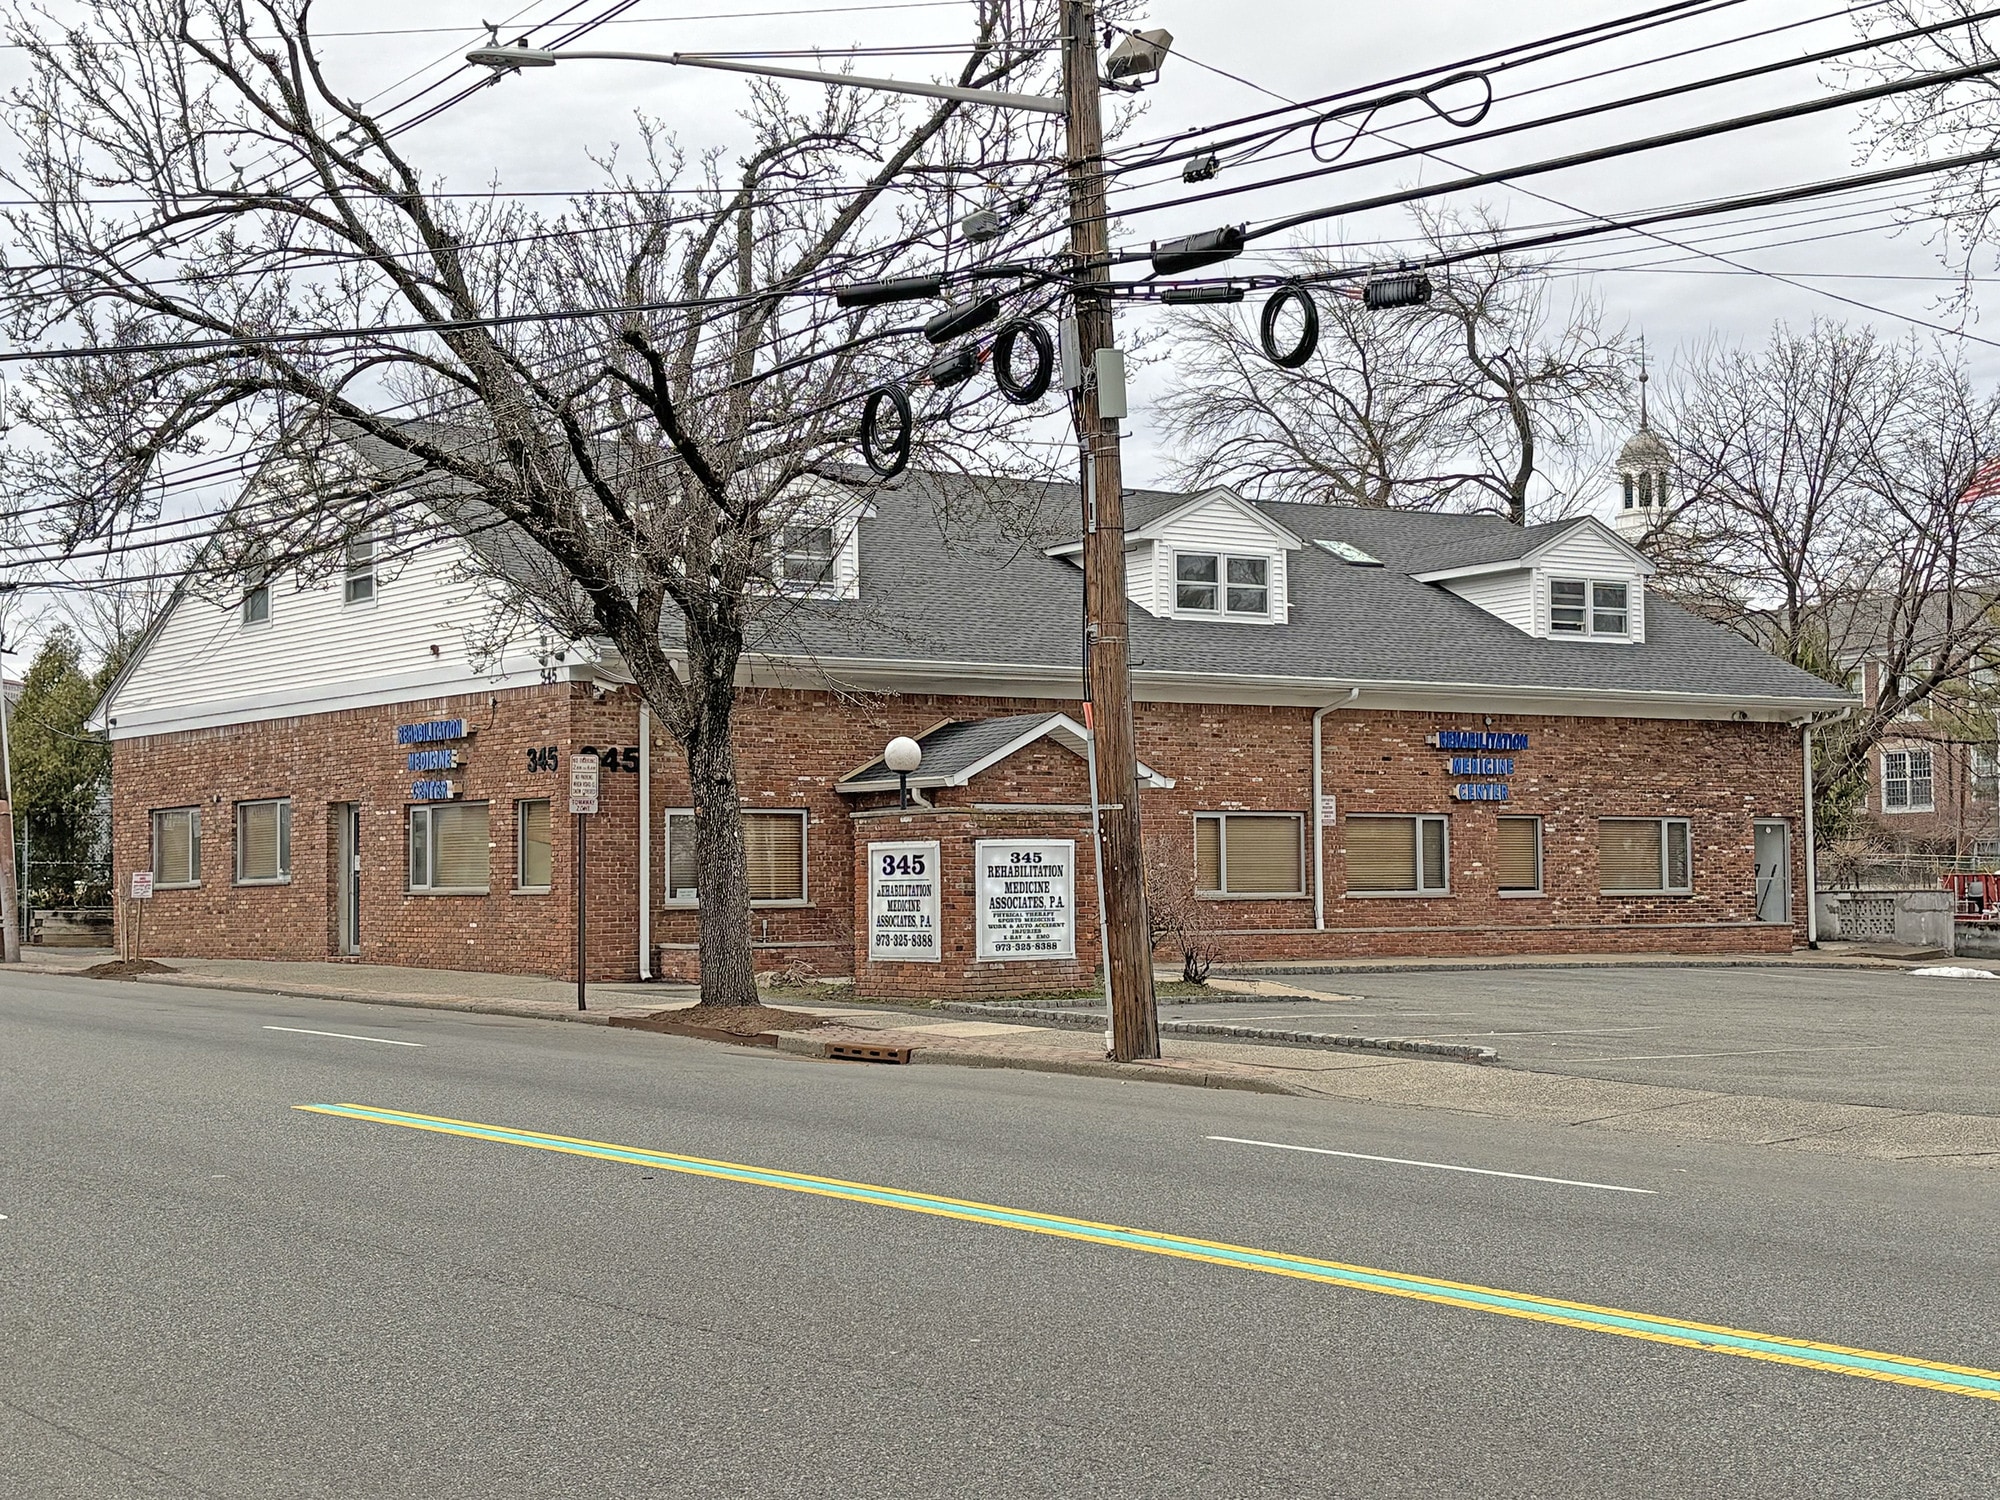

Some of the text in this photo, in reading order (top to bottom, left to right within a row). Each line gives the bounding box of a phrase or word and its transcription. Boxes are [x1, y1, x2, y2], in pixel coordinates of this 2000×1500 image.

[398, 719, 463, 744] REHABILITATION
[1437, 731, 1528, 750] REHABILITATION
[408, 750, 454, 771] MEDICINE
[527, 746, 558, 772] 345
[1452, 758, 1514, 775] MEDICINE
[412, 780, 450, 799] CENTER
[1458, 784, 1508, 800] CENTER
[882, 854, 925, 875] 345
[1010, 852, 1042, 863] 345
[988, 865, 1064, 878] REHABILITATION
[1004, 881, 1050, 894] MEDICINE
[887, 899, 921, 912] MEDICINE
[989, 896, 1047, 910] ASSOCIATES,
[876, 914, 918, 929] ASSOCIATES,
[876, 934, 933, 947] 973-325-8388
[995, 943, 1057, 952] 973-325-8388
